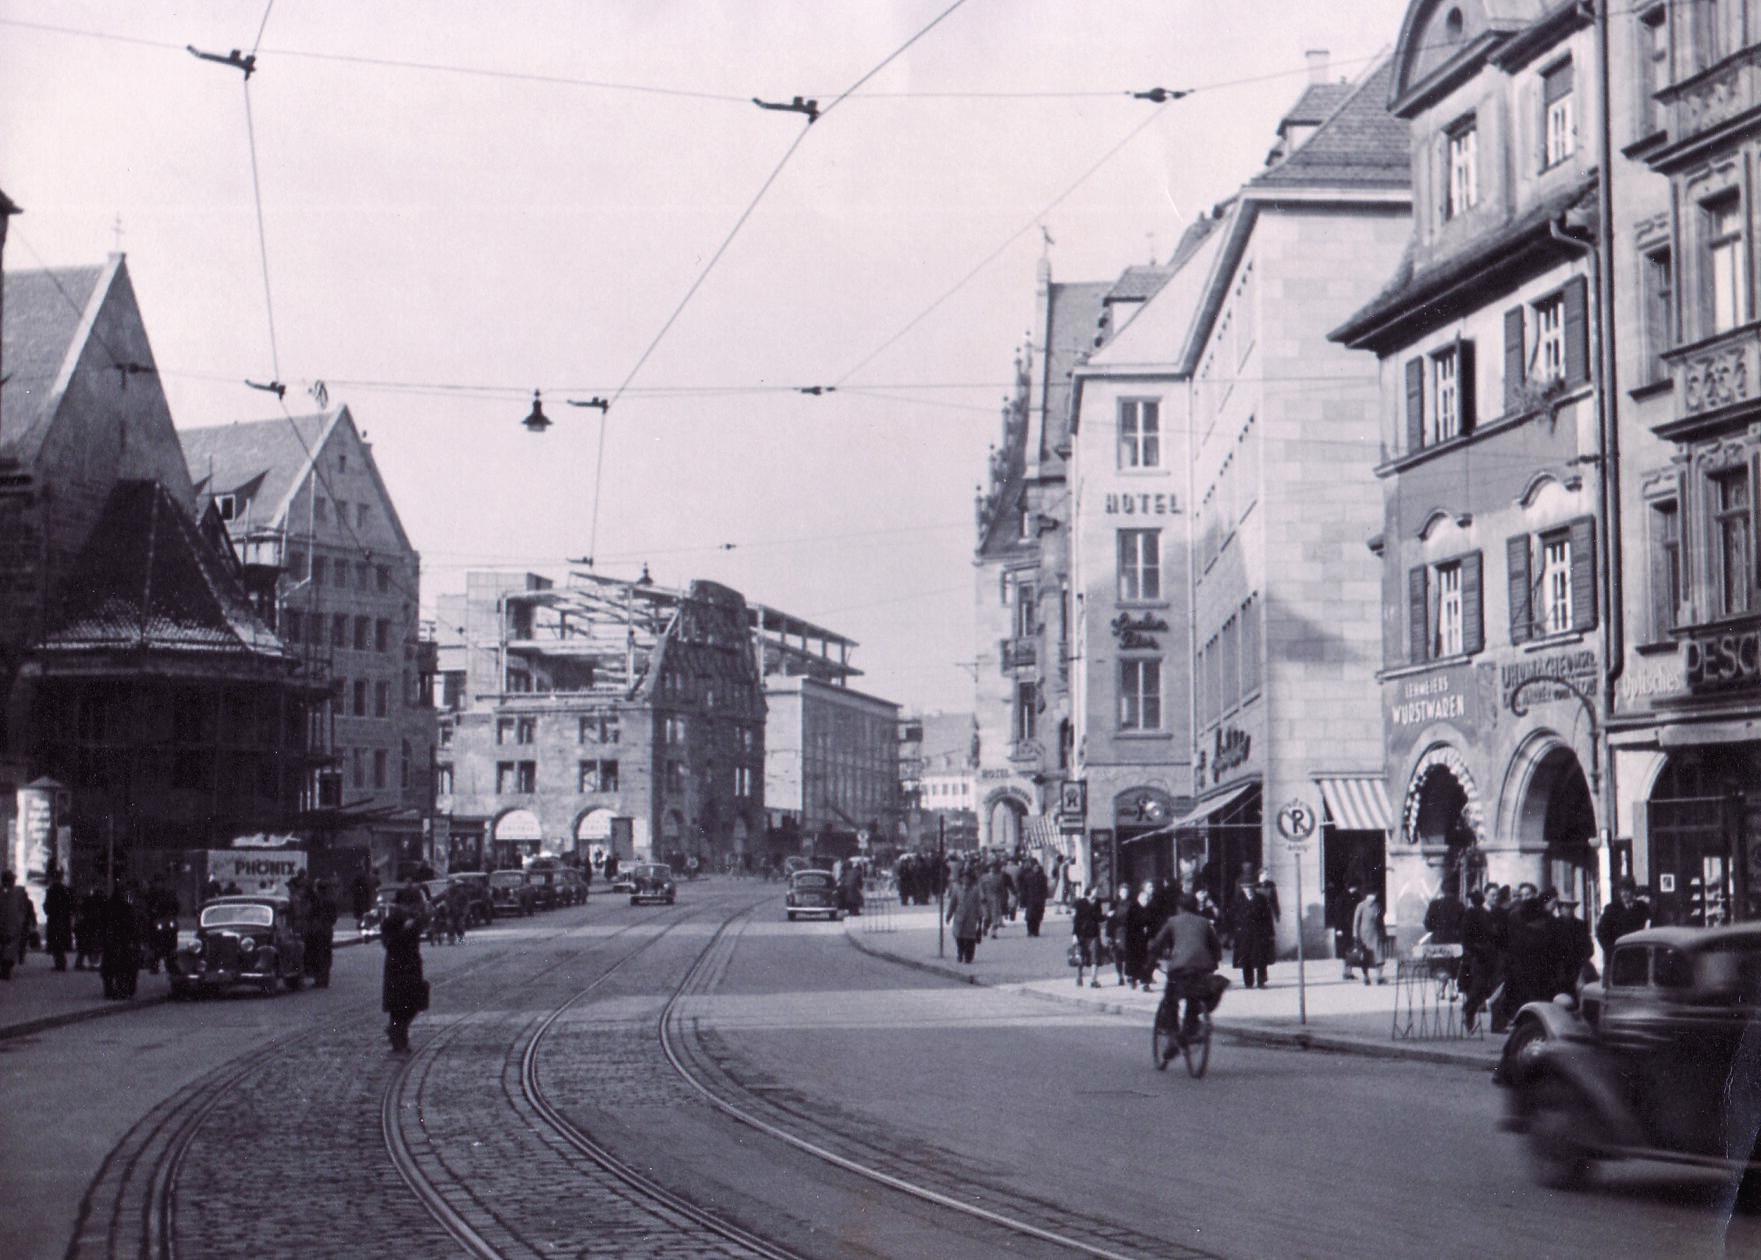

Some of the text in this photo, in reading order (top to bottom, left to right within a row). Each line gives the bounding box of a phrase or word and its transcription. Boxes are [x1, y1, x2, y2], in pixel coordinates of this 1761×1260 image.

[1105, 493, 1183, 515] HOTEL
[1687, 629, 1761, 681] PESC
[1391, 693, 1465, 726] WURSTWAREN
